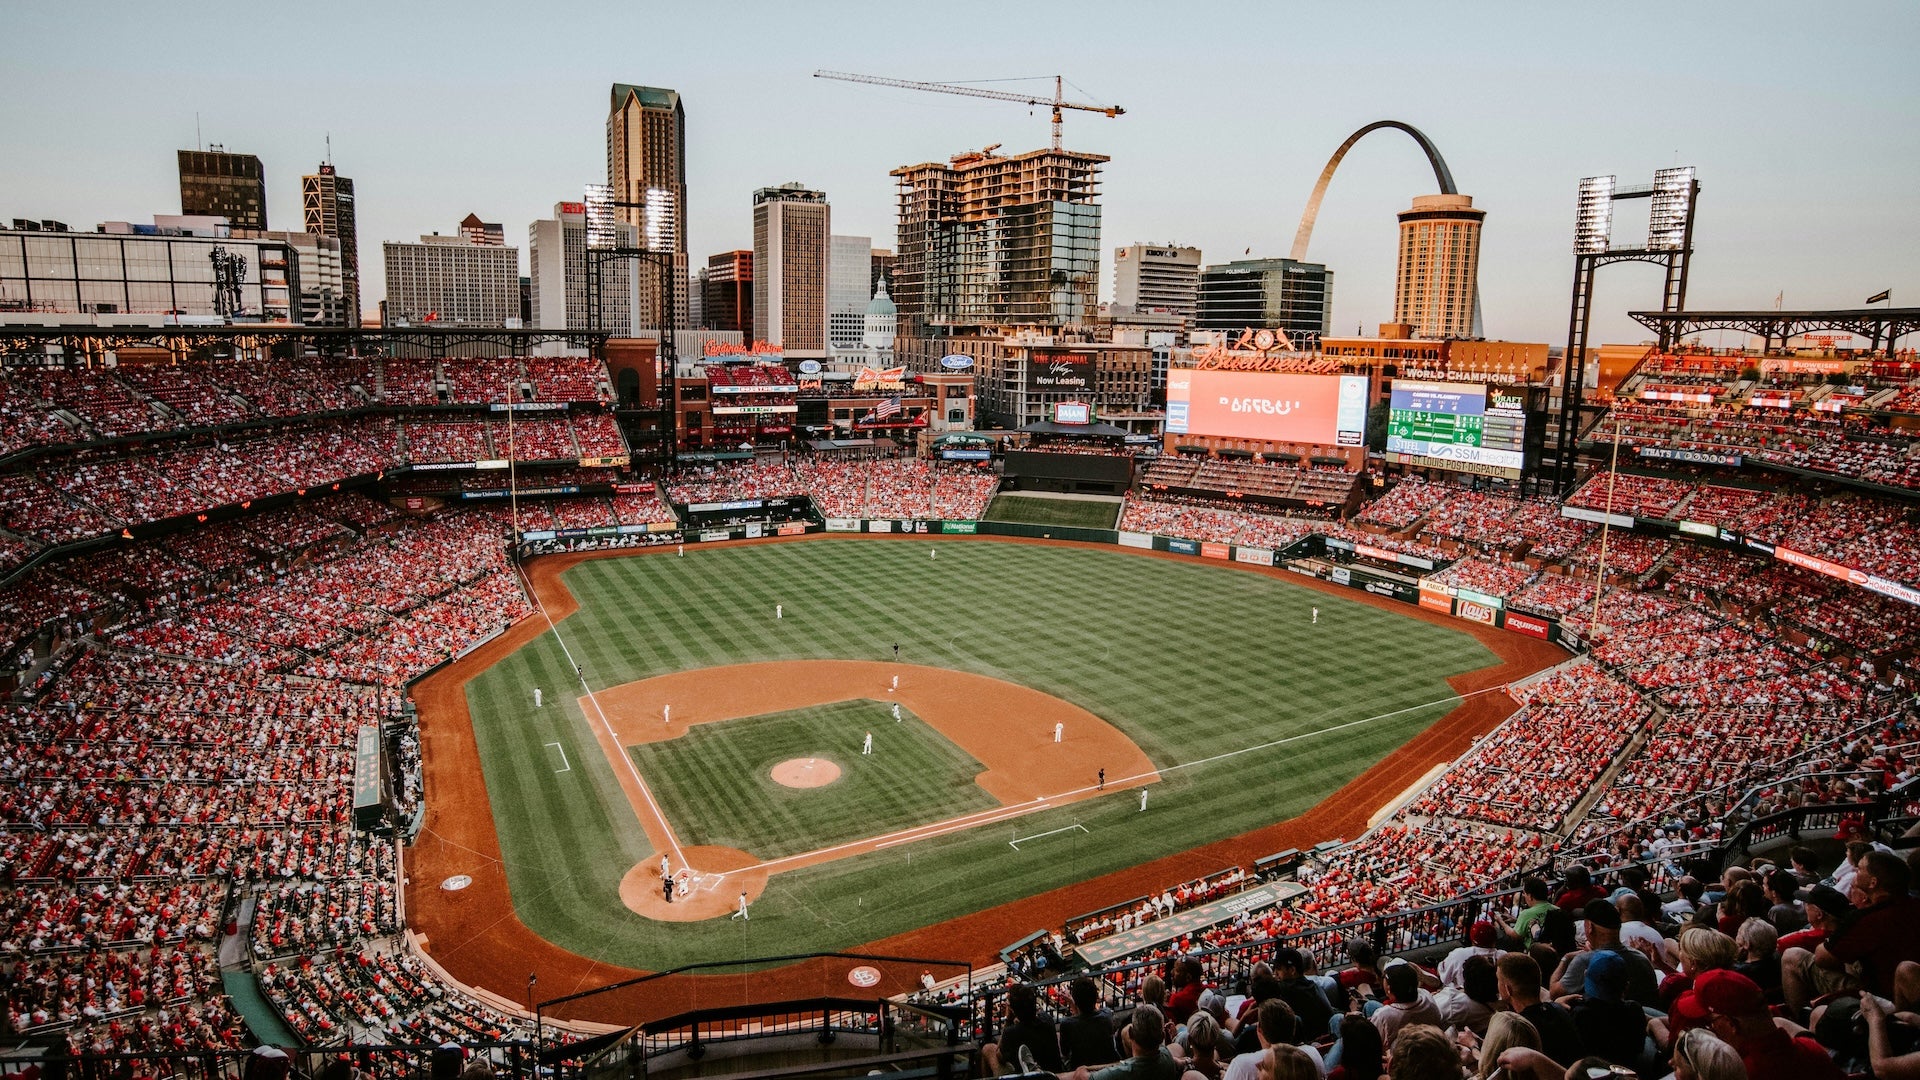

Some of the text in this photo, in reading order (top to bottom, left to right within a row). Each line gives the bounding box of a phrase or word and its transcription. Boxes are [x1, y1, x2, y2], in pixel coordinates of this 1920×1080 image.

[705, 340, 784, 356] Cardinals Nation
[1034, 355, 1088, 364] ONE CARDINAL
[1192, 346, 1342, 373] Budweiser
[1792, 361, 1839, 369] BUDWEISER
[1056, 377, 1086, 386] Leasing
[1406, 368, 1516, 383] WORLD CHAMPIONS
[854, 382, 905, 390] BREW HOUSE
[1396, 438, 1420, 450] STIFEL
[1645, 448, 1671, 457] THAT'S
[1423, 457, 1443, 468] LOUIS
[1784, 552, 1821, 570] HOLLYWOOD
[1869, 579, 1911, 599] HOMETOWN
[1508, 618, 1544, 633] EQUIFAX
[1221, 898, 1246, 908] WORLD
[1226, 893, 1274, 912] CHAMPIONS
